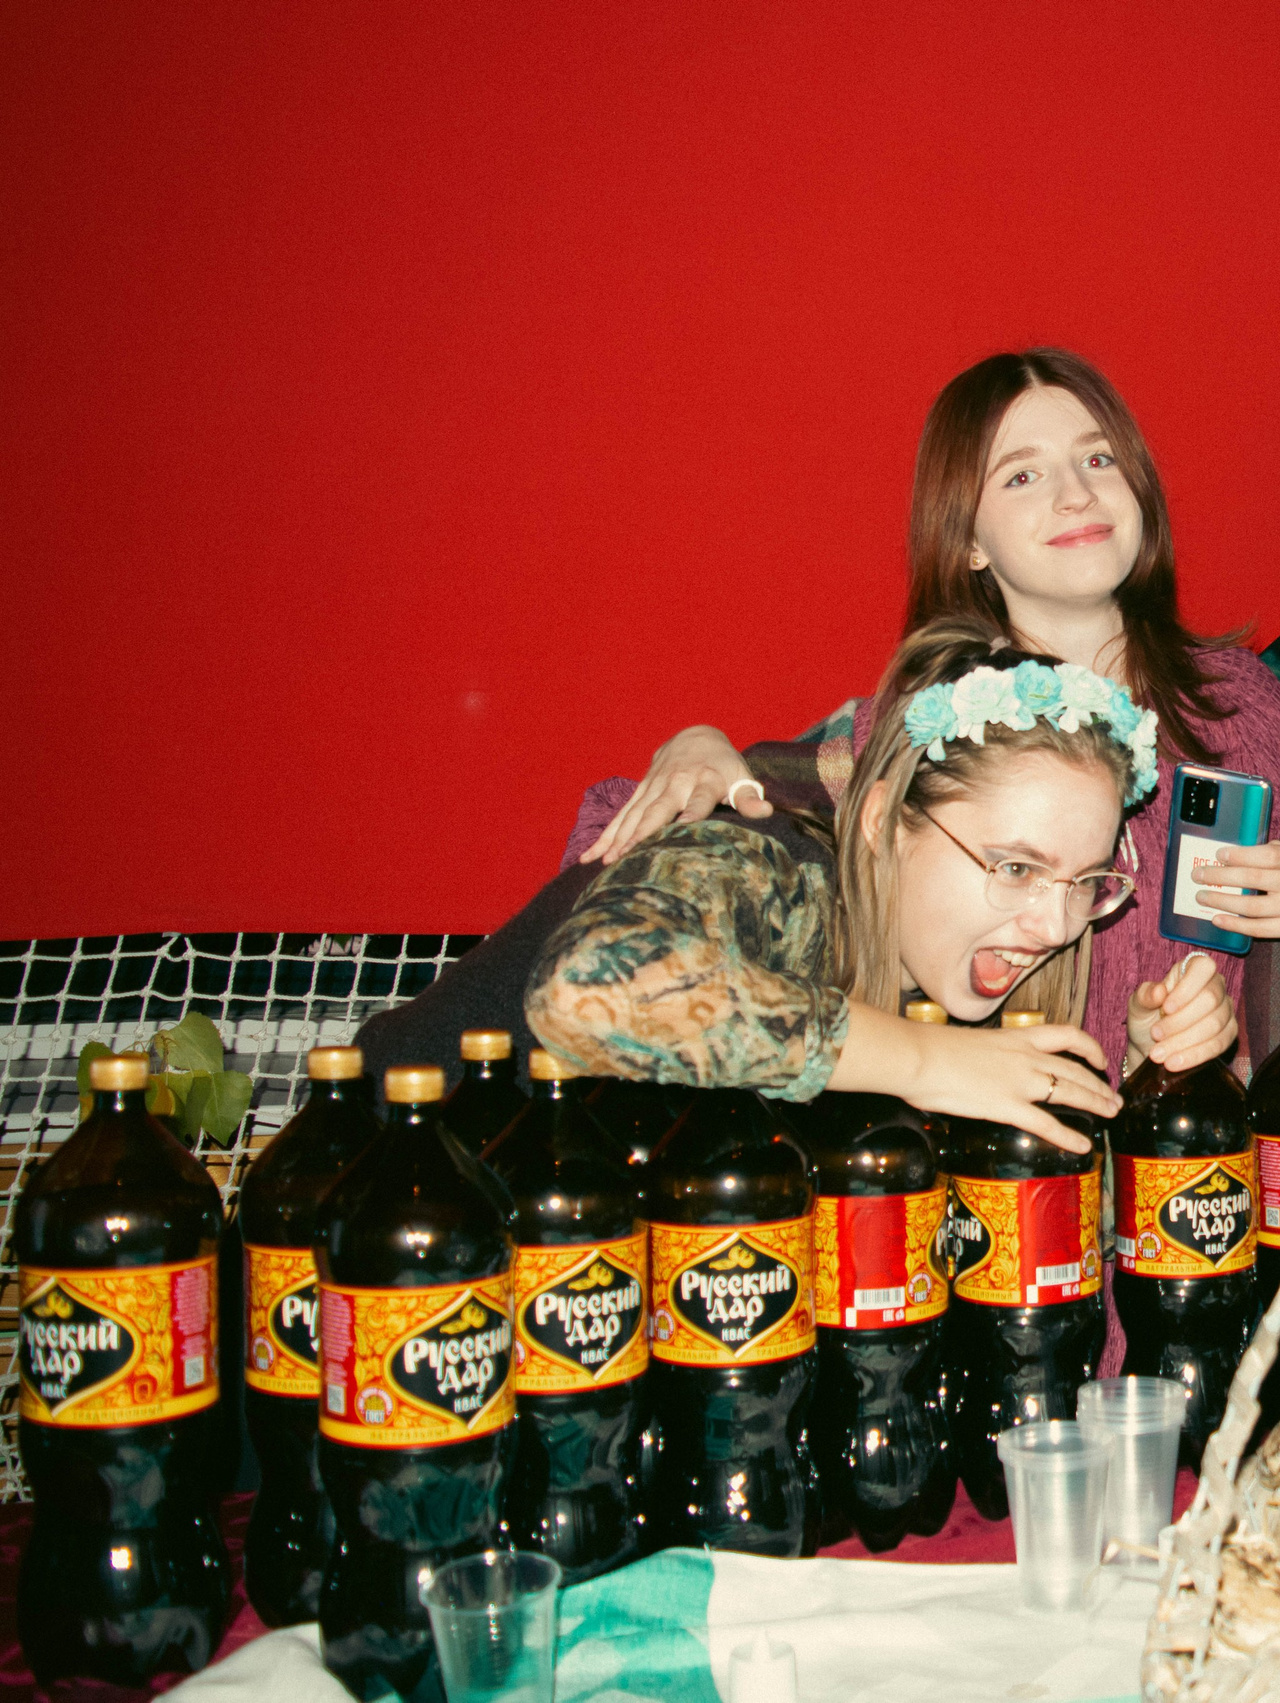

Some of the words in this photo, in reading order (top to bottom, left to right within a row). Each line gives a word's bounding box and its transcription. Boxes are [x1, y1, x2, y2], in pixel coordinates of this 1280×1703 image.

[1168, 1187, 1250, 1229] Русский
[1193, 1215, 1236, 1241] Дар
[1205, 1243, 1228, 1255] КВАС
[680, 1264, 791, 1310] Русский
[535, 1279, 641, 1333] Русский
[707, 1295, 765, 1327] Дар
[566, 1313, 621, 1347] Дар
[721, 1327, 752, 1342] КВАС
[31, 1348, 82, 1385] Дар
[404, 1320, 511, 1380] Русский
[581, 1347, 610, 1364] КВАС
[437, 1357, 494, 1395] Дар
[454, 1393, 483, 1413] КВАС
